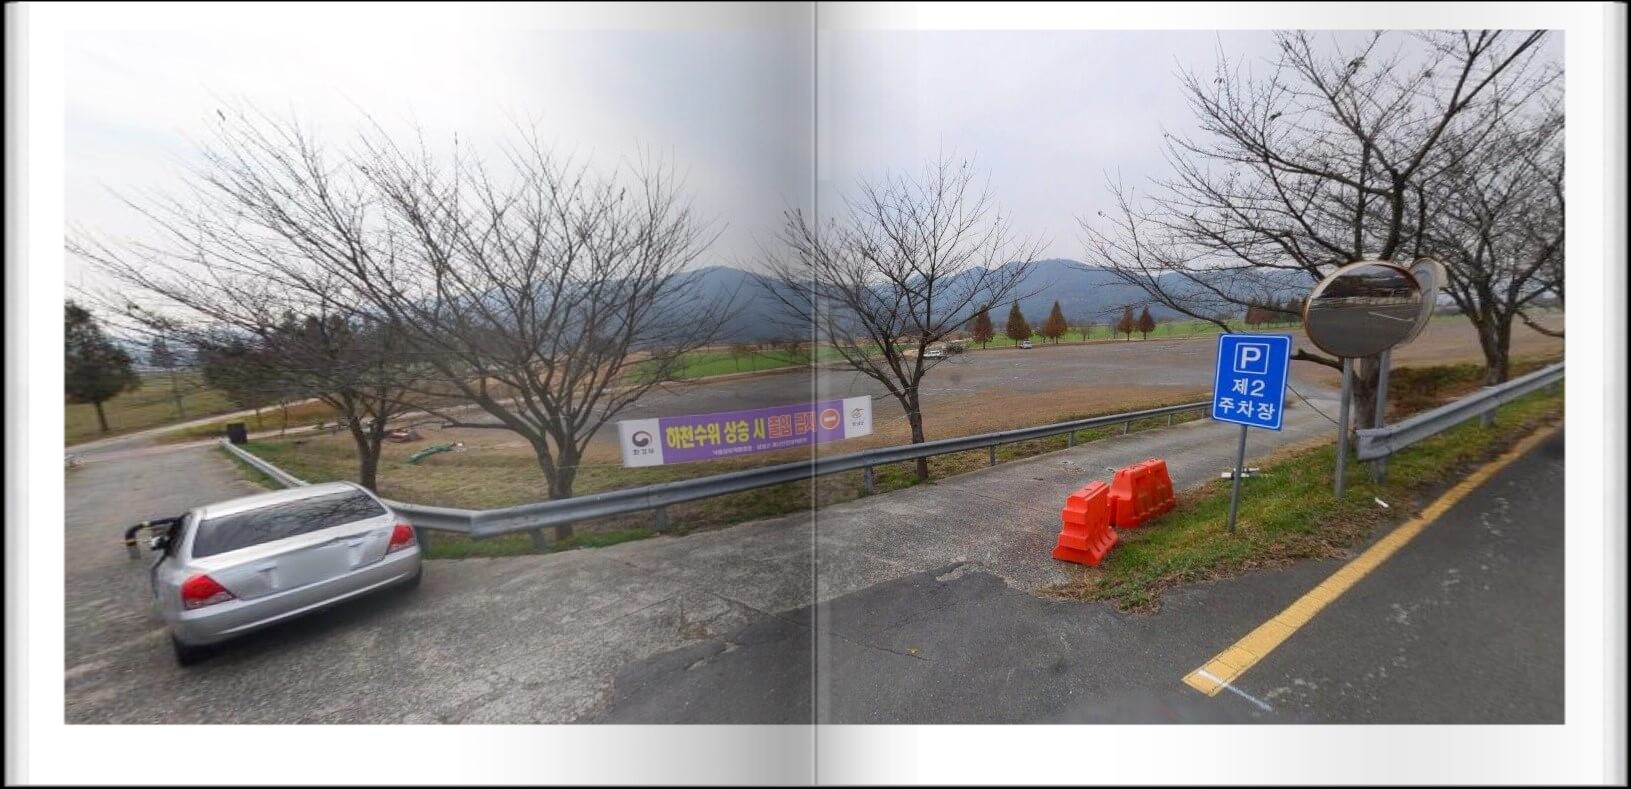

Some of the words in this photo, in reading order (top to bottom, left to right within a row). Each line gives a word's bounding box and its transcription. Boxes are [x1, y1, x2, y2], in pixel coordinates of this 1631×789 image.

[1241, 346, 1261, 369] P
[1231, 377, 1266, 397] 제2
[1218, 397, 1276, 420] 주차장
[665, 424, 721, 449] 하천수위
[724, 420, 750, 445] 상승
[753, 418, 766, 439] 시
[768, 414, 792, 438] 출입
